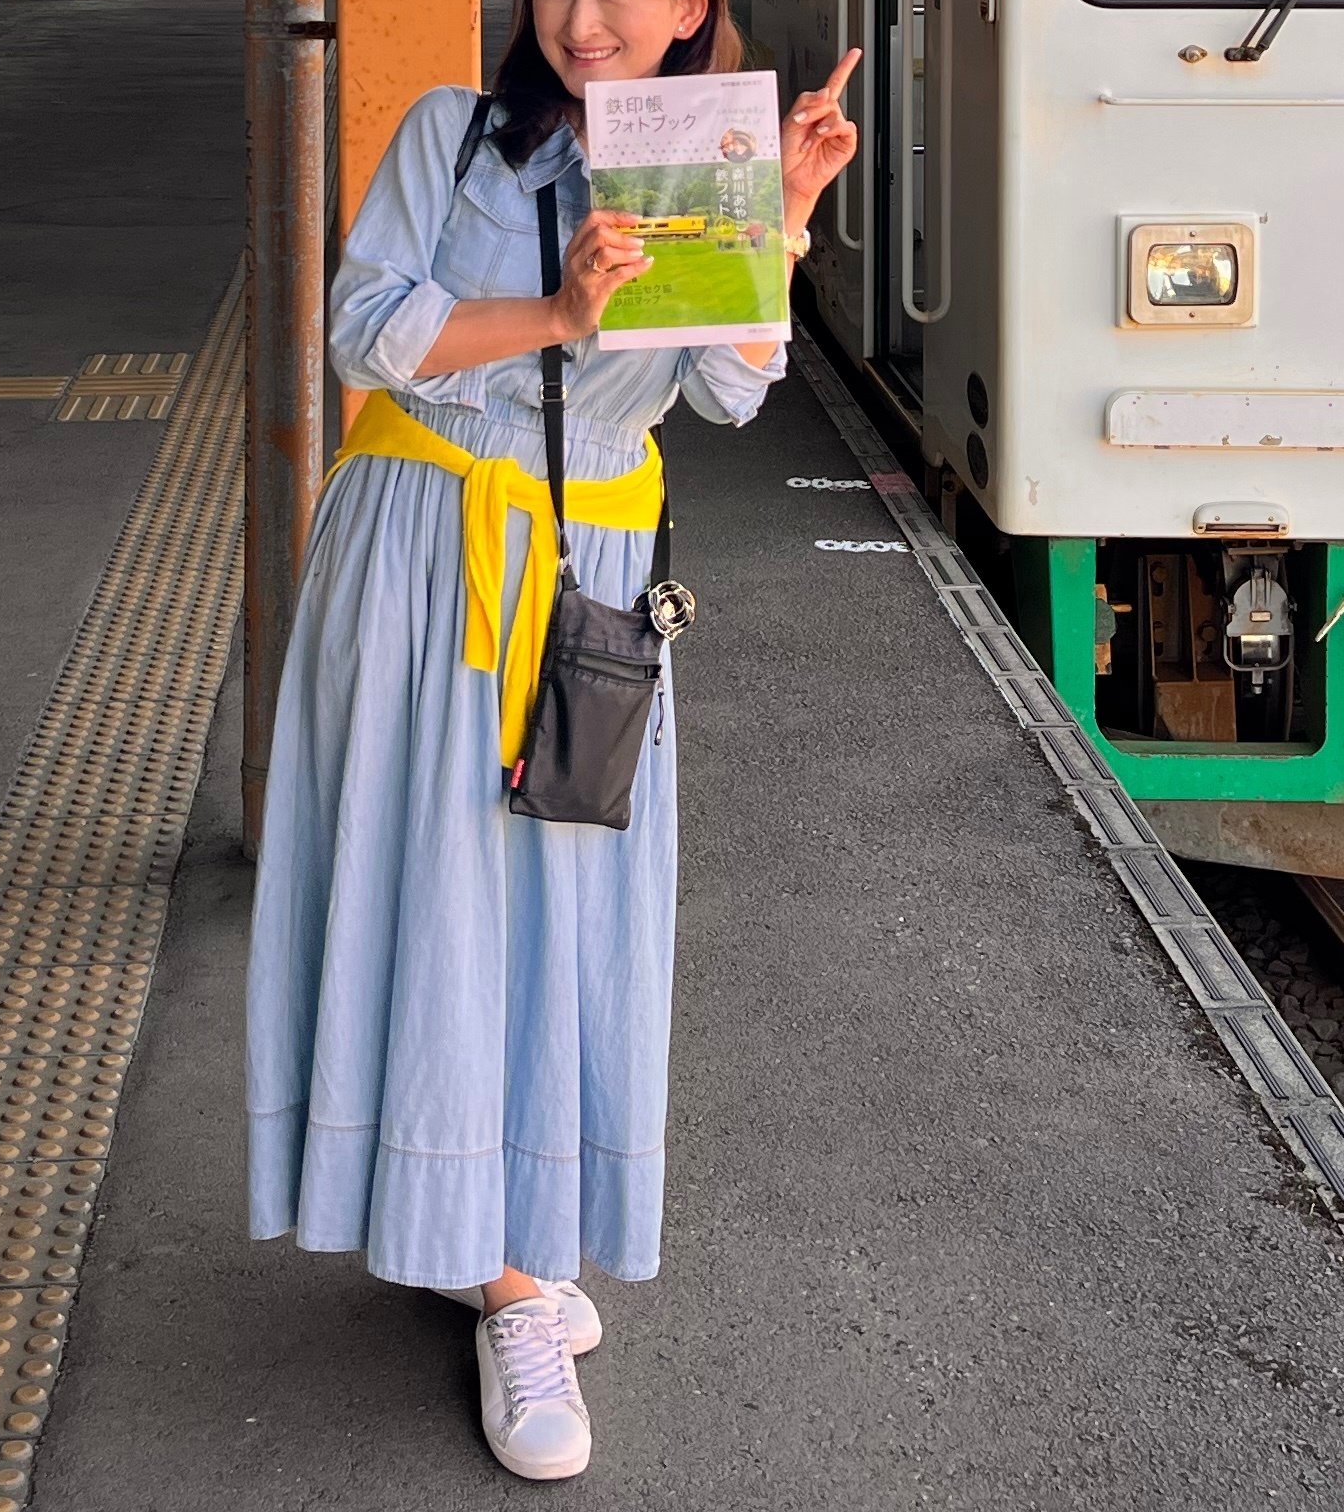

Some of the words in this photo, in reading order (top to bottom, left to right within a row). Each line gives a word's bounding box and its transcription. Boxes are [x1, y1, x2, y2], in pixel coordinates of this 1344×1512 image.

[605, 94, 664, 115] 鉄印帳
[607, 113, 697, 135] フォトブック
